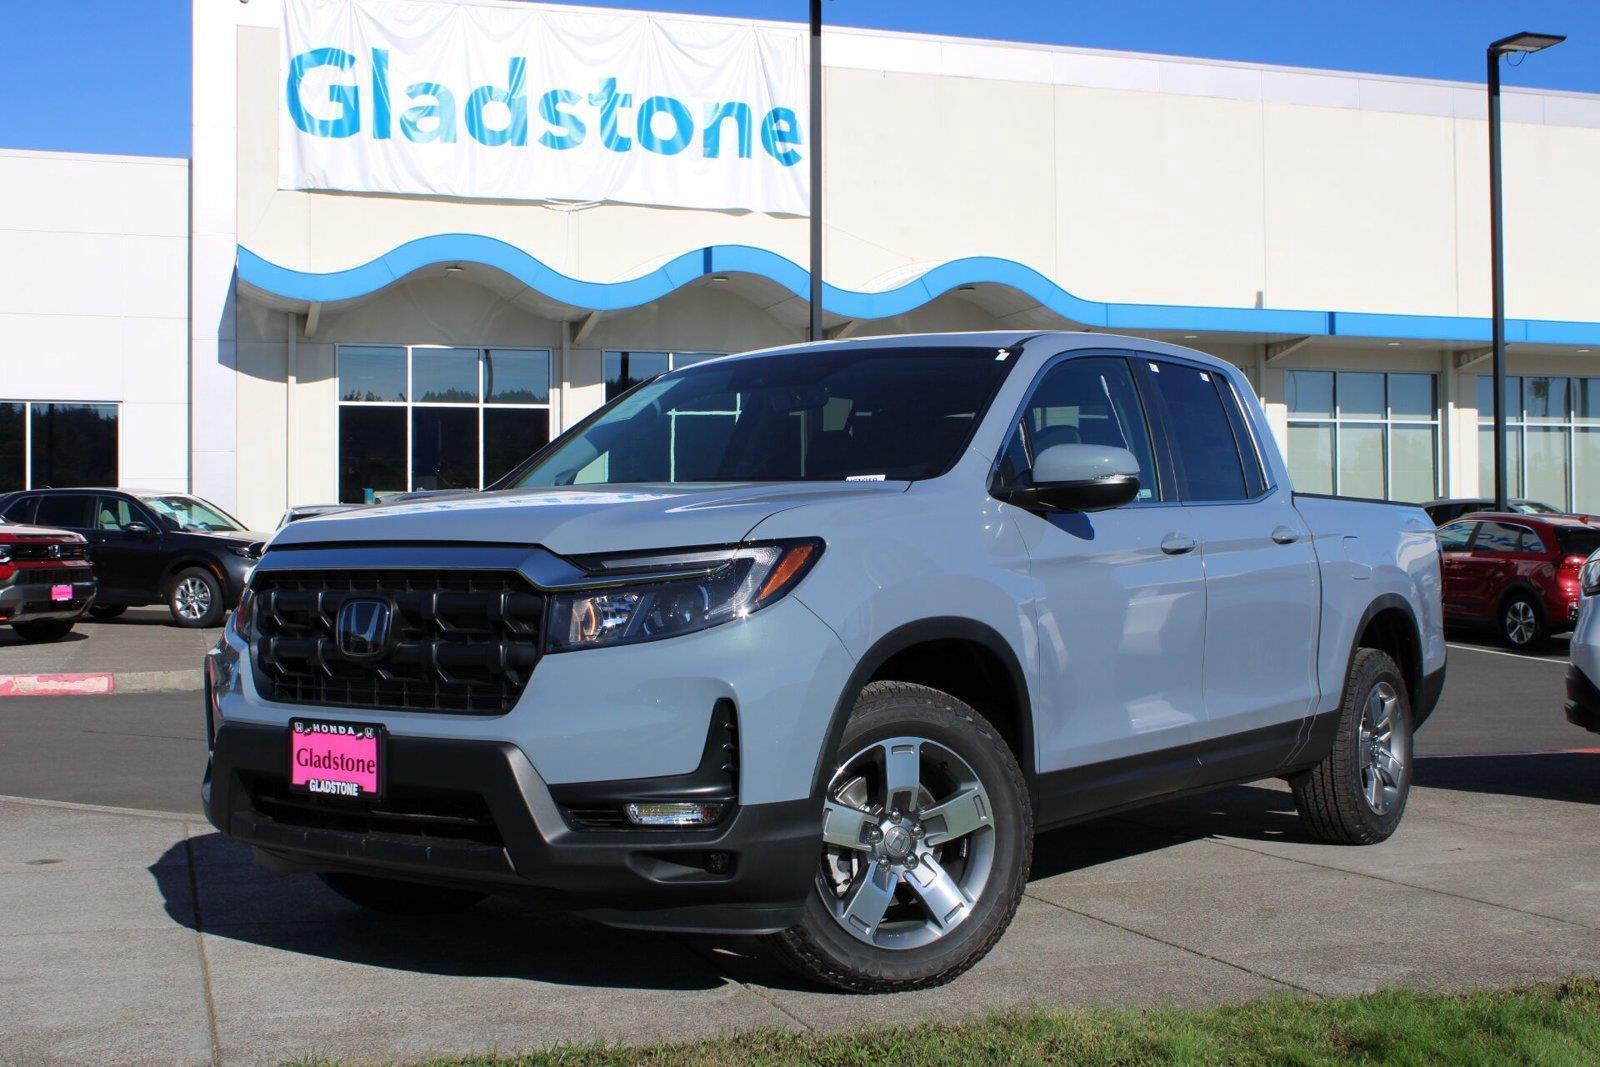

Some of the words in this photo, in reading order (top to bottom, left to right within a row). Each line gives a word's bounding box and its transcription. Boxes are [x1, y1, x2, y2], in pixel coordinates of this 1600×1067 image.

[286, 47, 805, 168] Gladstone
[313, 723, 355, 735] HONDA
[296, 747, 376, 774] Gladstone
[309, 779, 359, 797] GLADSTONE
